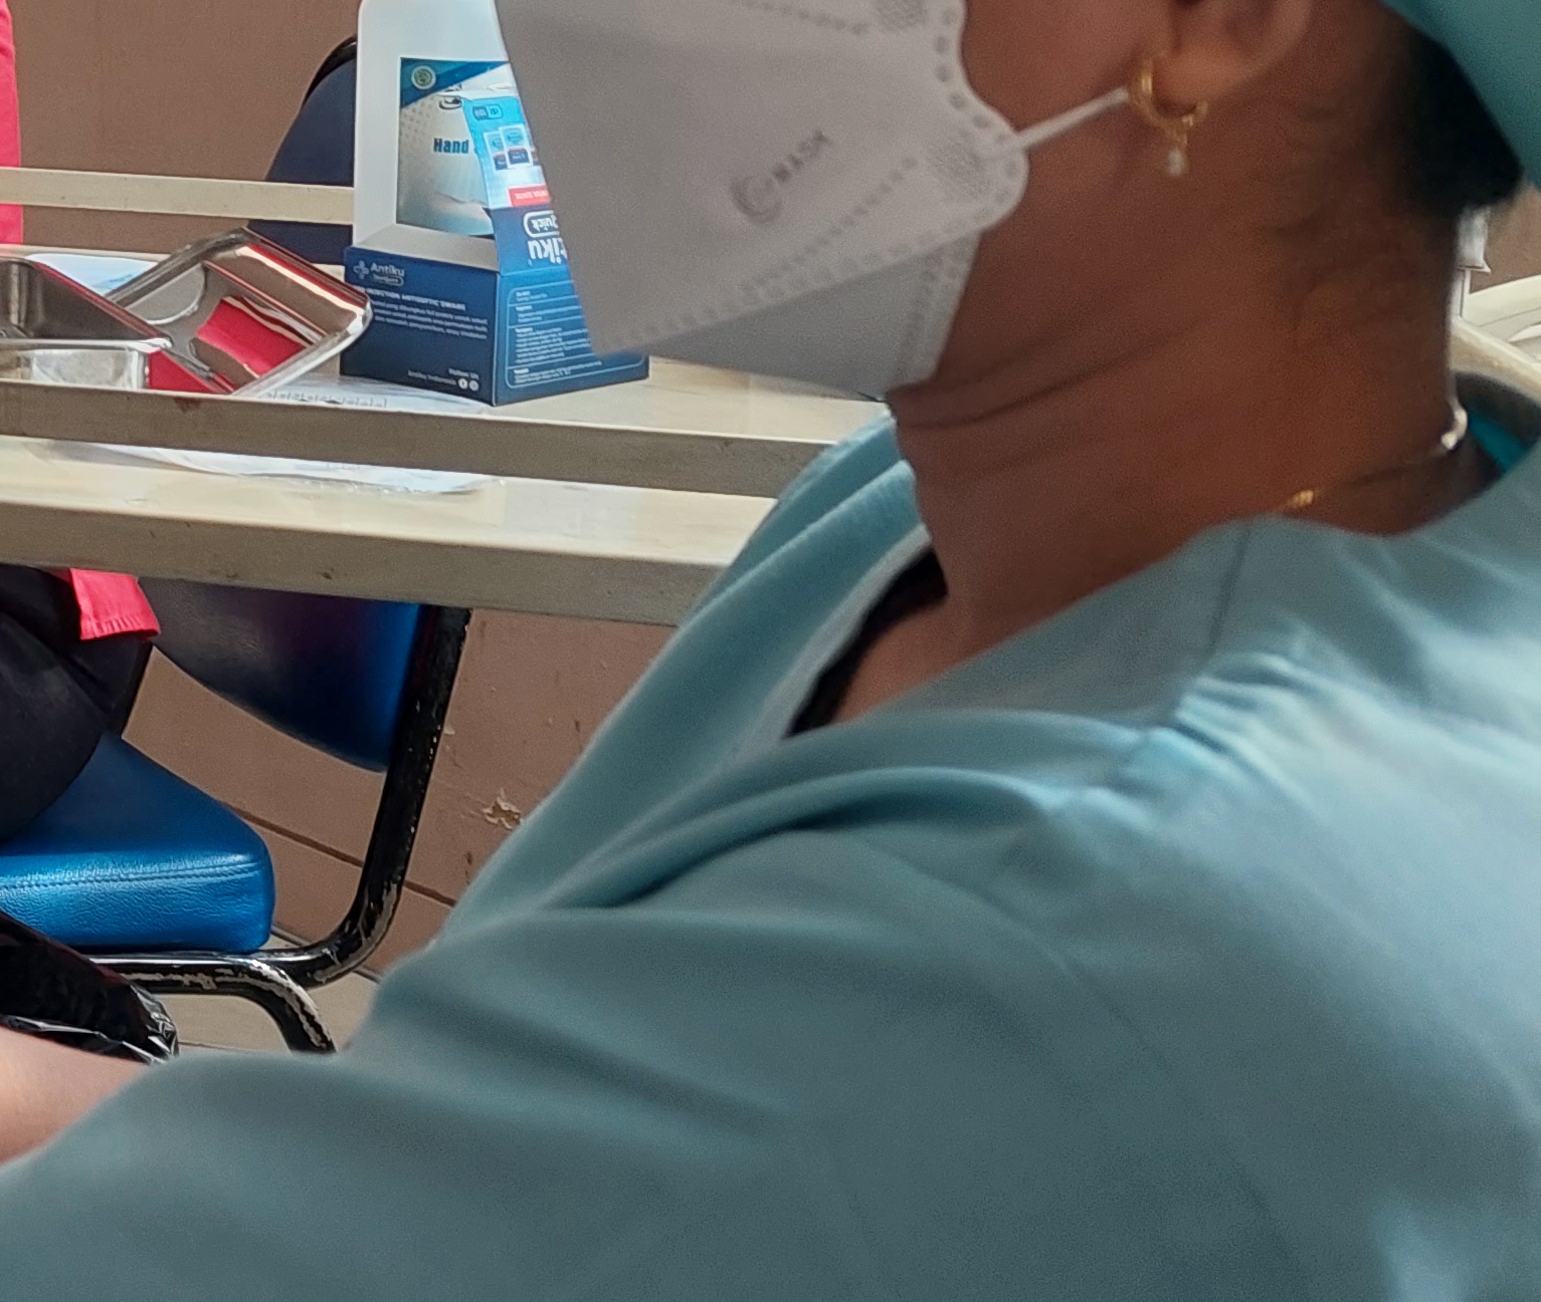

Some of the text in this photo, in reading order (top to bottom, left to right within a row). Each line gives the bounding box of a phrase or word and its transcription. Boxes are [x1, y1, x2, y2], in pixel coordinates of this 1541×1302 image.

[433, 137, 470, 154] Hand
[527, 237, 568, 265] tiku
[370, 262, 405, 278] Antiku
